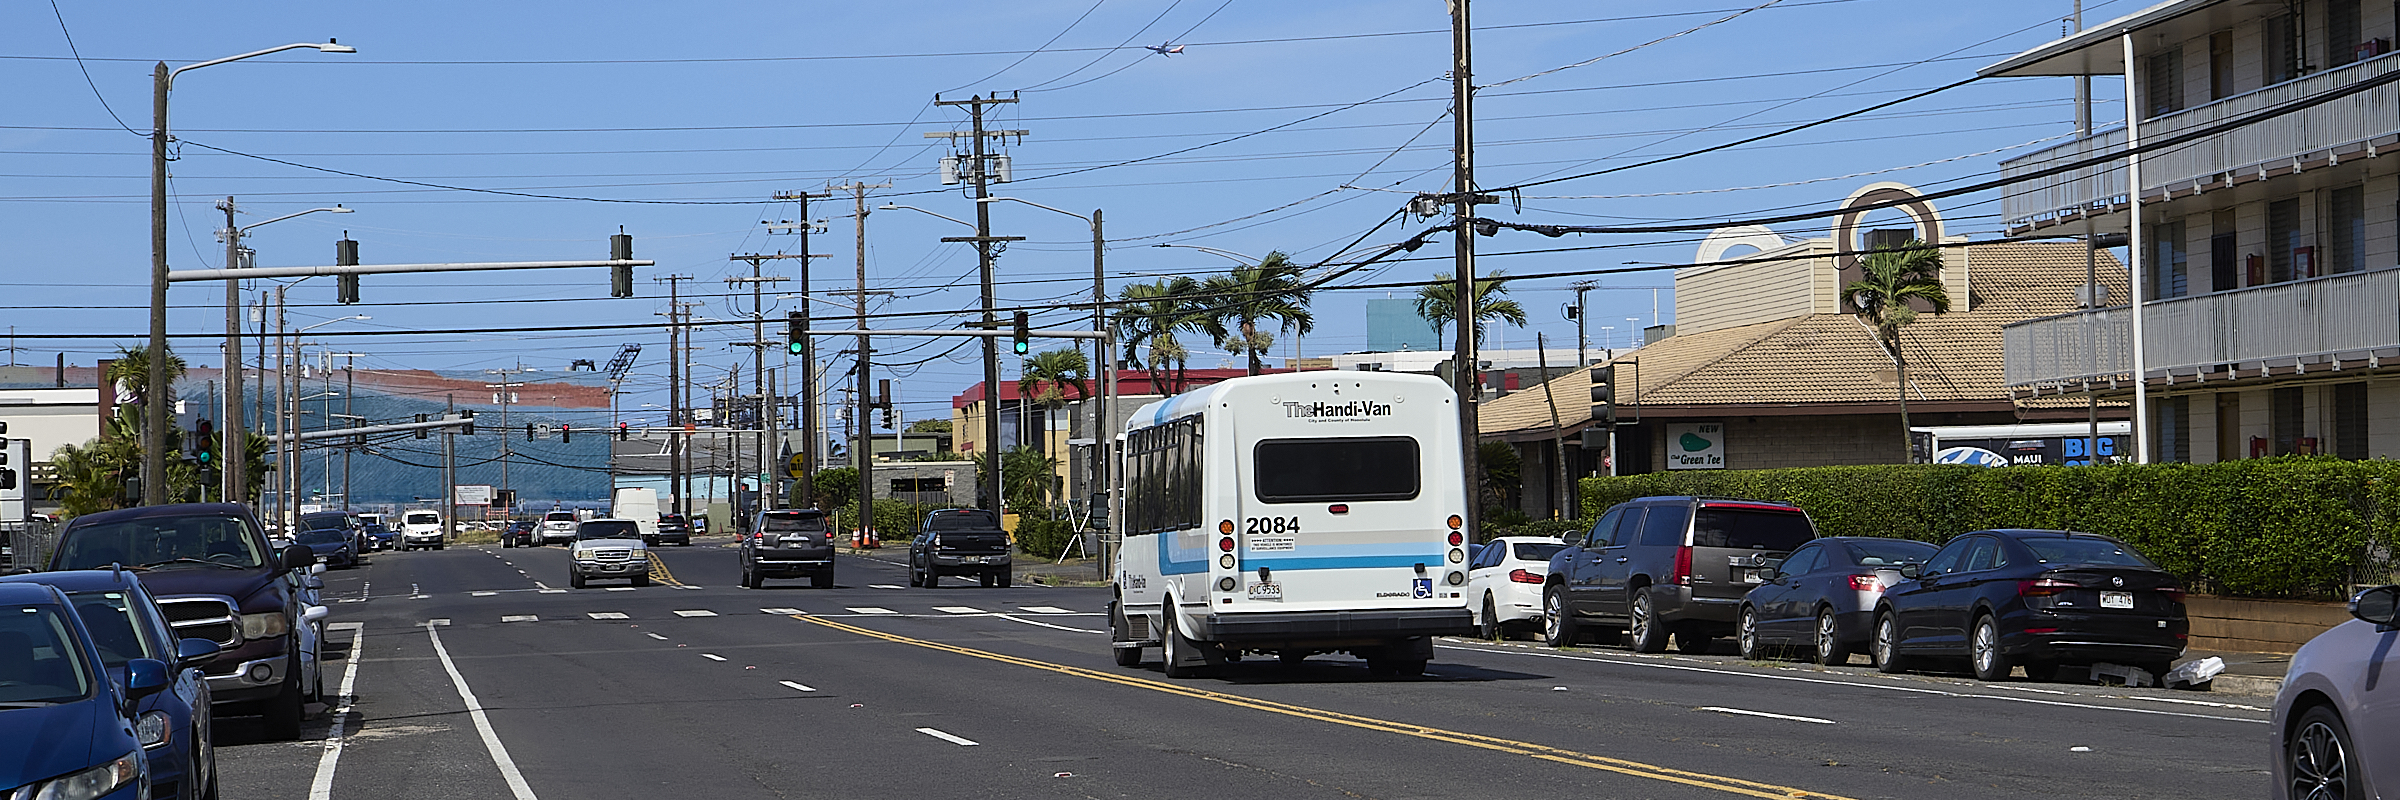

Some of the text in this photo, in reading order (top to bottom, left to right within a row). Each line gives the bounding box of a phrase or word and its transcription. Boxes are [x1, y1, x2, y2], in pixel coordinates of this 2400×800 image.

[1283, 401, 1391, 417] TheHandi-Van
[1698, 425, 1719, 434] NEW
[2065, 437, 2113, 457] BIG
[1680, 454, 1704, 465] Green
[1707, 454, 1721, 465] Tee
[2014, 454, 2042, 464] MAUI
[1246, 516, 1301, 535] 2084
